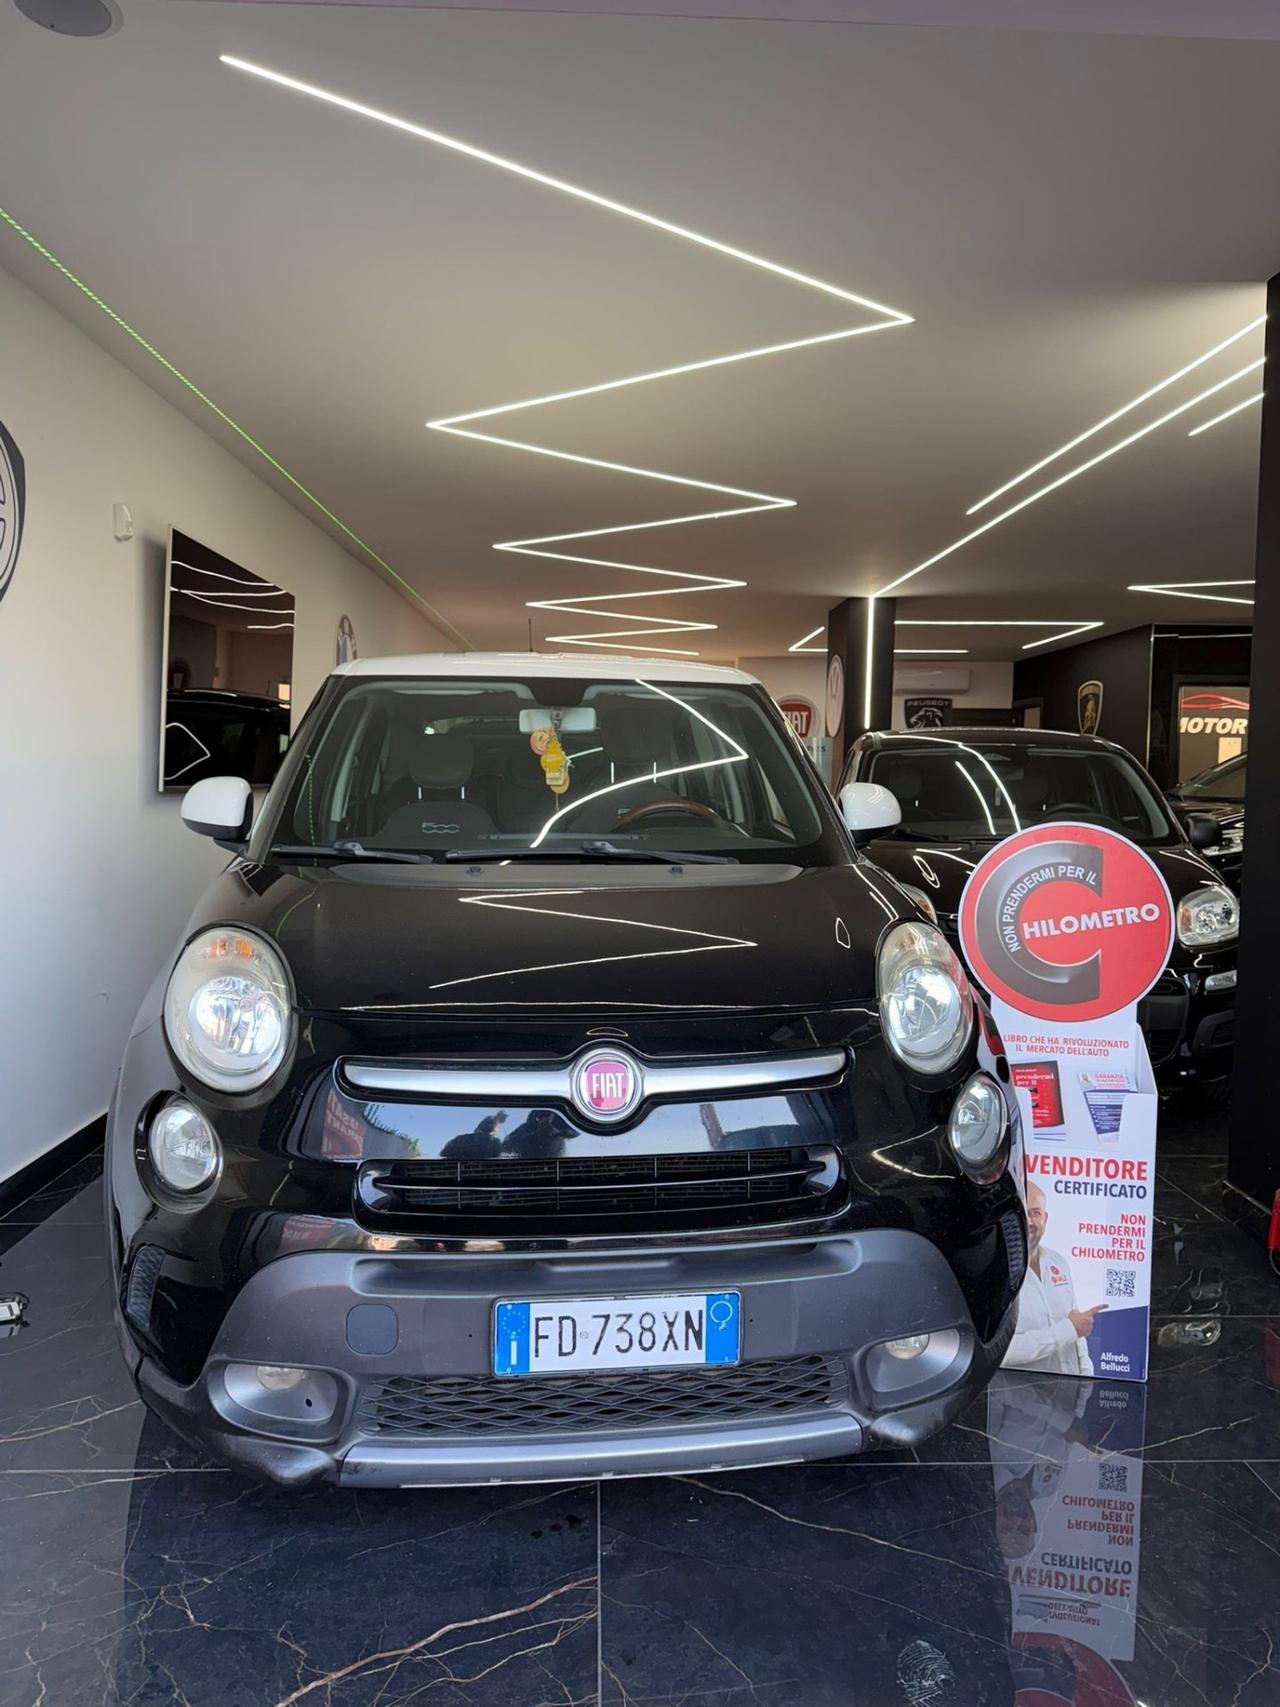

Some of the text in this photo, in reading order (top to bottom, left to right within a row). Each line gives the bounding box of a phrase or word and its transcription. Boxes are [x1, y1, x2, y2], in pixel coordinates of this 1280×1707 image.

[1003, 865, 1097, 952] NON PRENDERMI PER IL
[1003, 1034, 1129, 1049] LIBRO CHE HA RIVOLUZIONATO
[1026, 1045, 1065, 1055] MERCATO
[1067, 1047, 1109, 1057] DELL'AUTO
[592, 1073, 624, 1099] FIAT
[1025, 1154, 1148, 1181] VENDITORE
[1054, 1180, 1147, 1199] CERTIFICATO
[1120, 1213, 1146, 1225] NON
[1079, 1223, 1146, 1238] PRENDERMI
[1112, 1238, 1146, 1250] PER IL
[1071, 1247, 1145, 1262] CHILOMETRO
[1101, 1352, 1129, 1363] Alfredo
[1101, 1362, 1130, 1373] Bellucci
